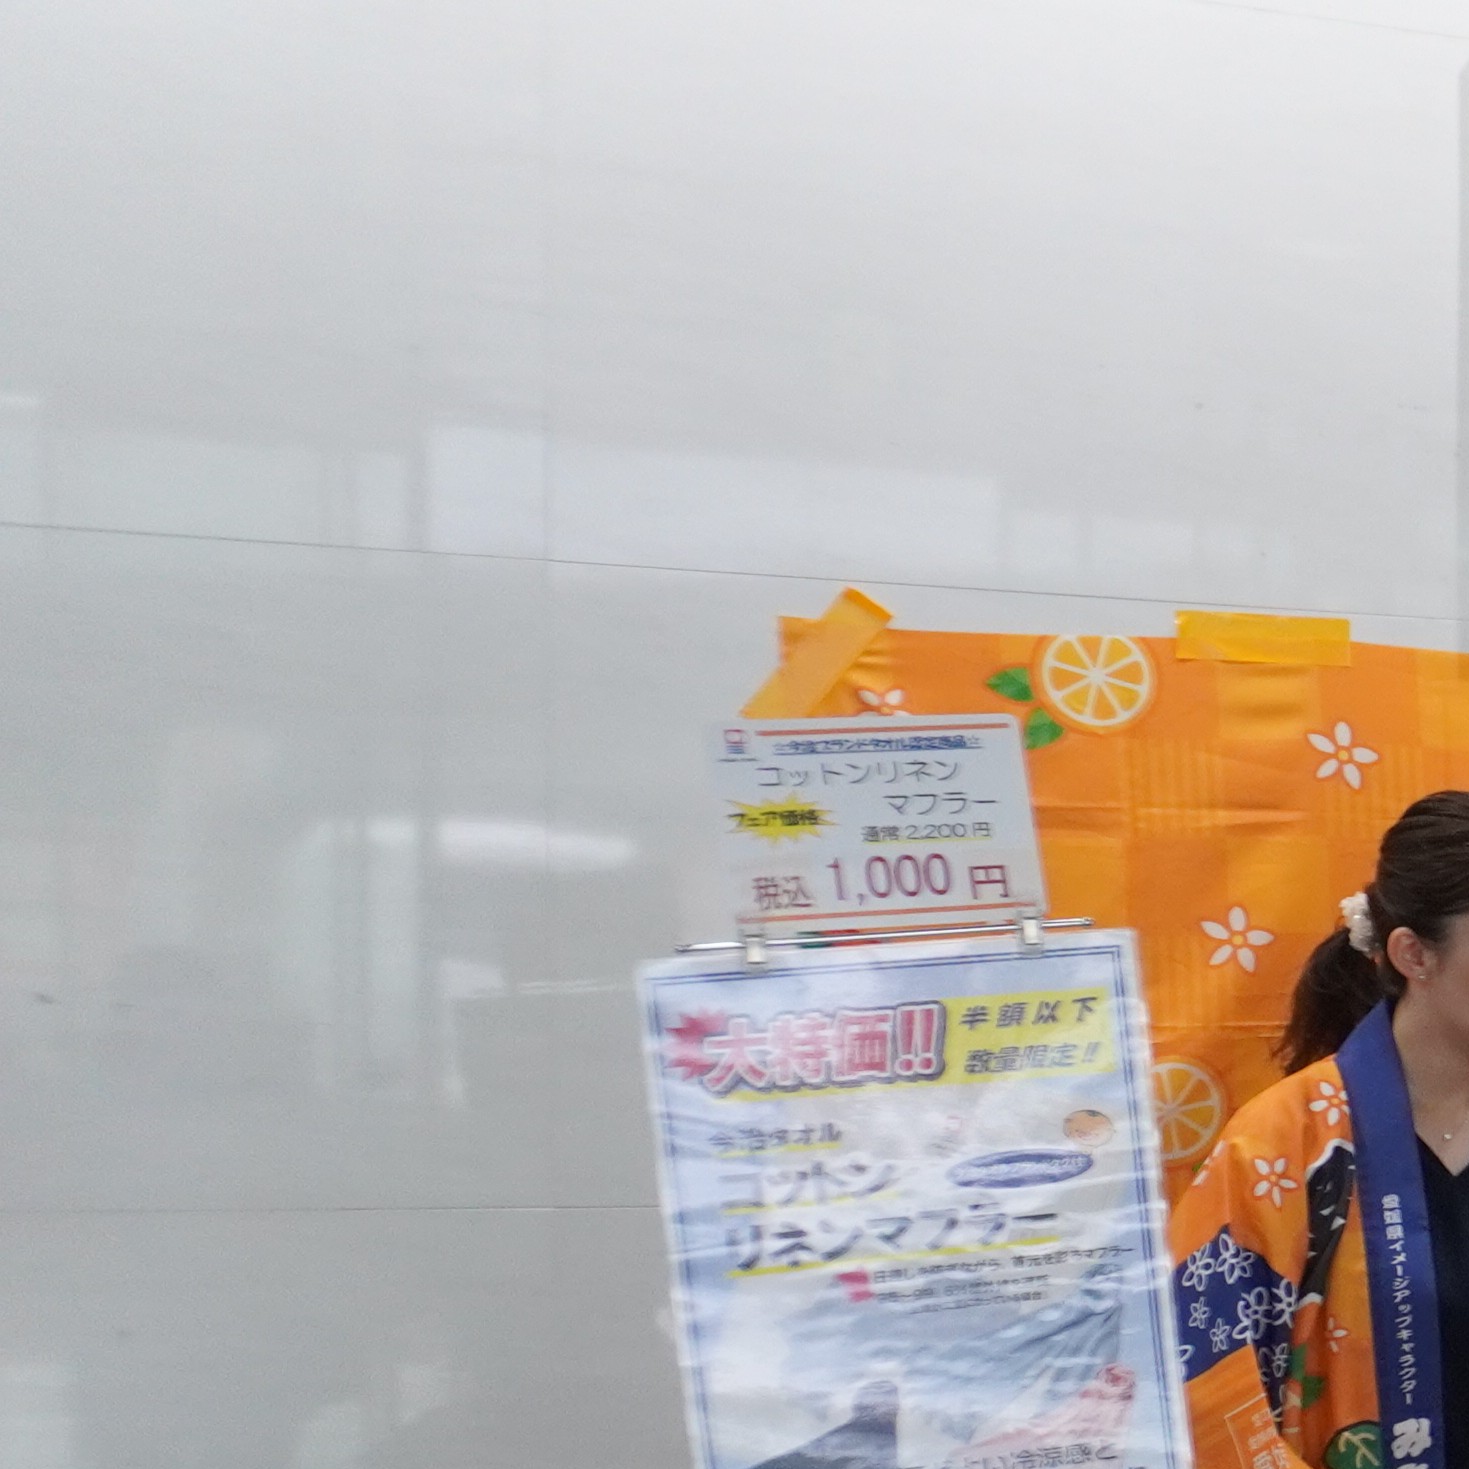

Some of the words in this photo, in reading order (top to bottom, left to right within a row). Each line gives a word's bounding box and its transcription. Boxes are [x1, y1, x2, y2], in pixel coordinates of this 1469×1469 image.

[756, 760, 961, 787] コットンリネン
[727, 807, 823, 827] フェア価格
[883, 791, 998, 816] マフラー
[752, 874, 818, 910] 税込
[826, 853, 952, 906] 1,000
[968, 864, 1011, 901] 円
[718, 1160, 895, 1209] コットン
[722, 1200, 1058, 1271] リネンマフラー
